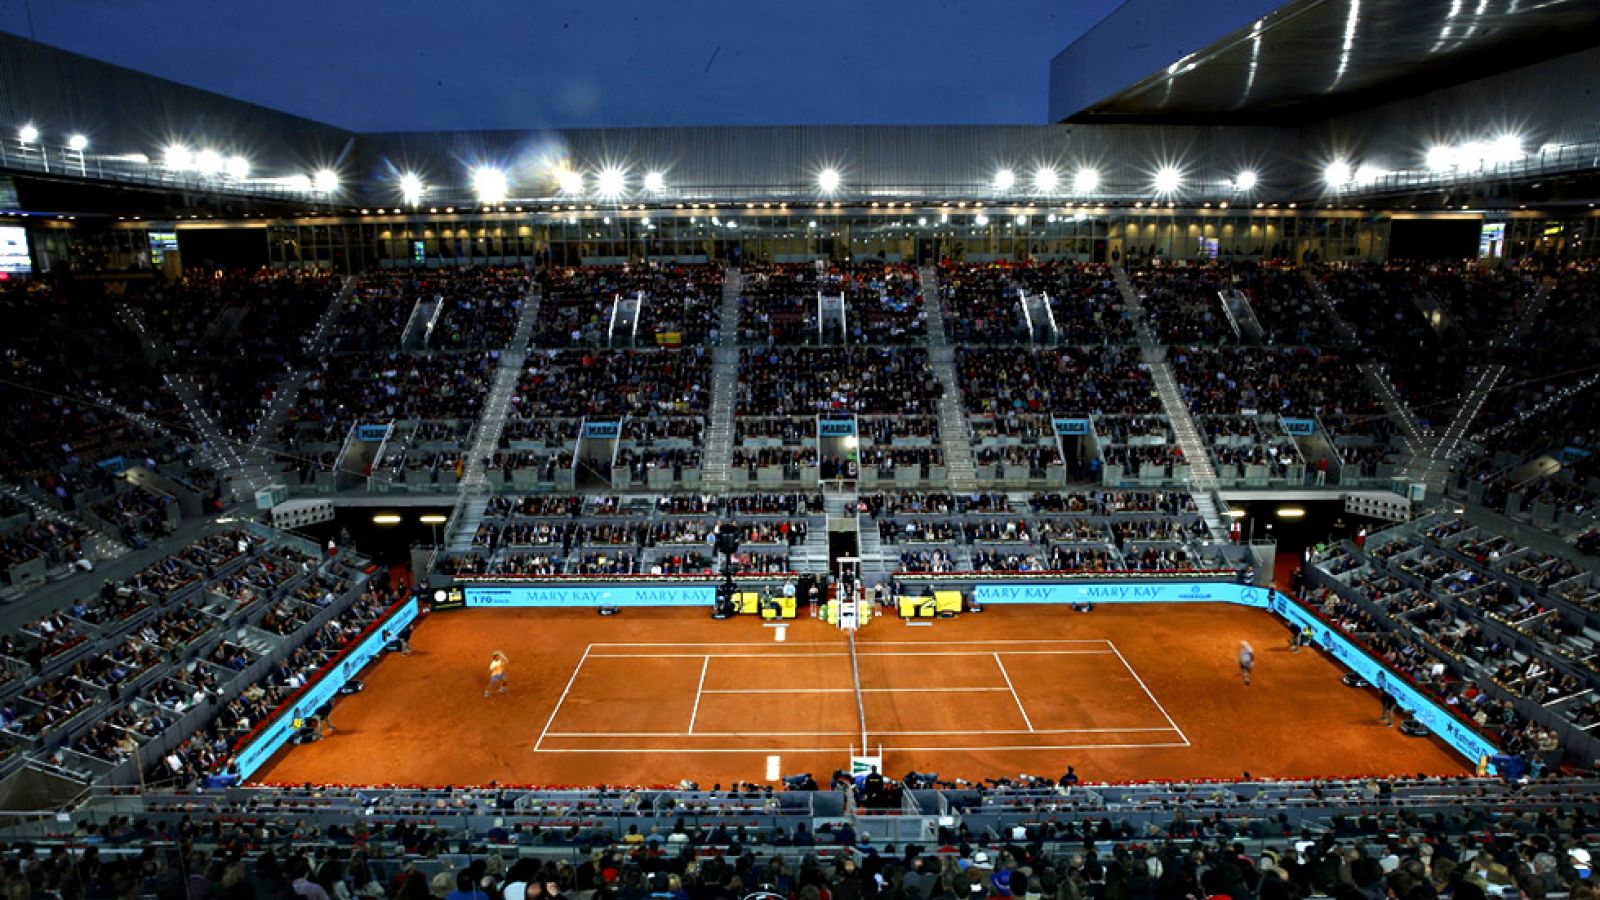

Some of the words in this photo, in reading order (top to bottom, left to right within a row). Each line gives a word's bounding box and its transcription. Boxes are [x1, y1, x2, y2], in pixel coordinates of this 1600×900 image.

[822, 424, 851, 434] MARCA
[526, 591, 567, 602] MARY
[572, 591, 600, 602] KAY
[635, 590, 677, 601] MARY
[682, 590, 709, 601] KAY
[977, 587, 1020, 600] MARY
[1087, 586, 1129, 599] MARY
